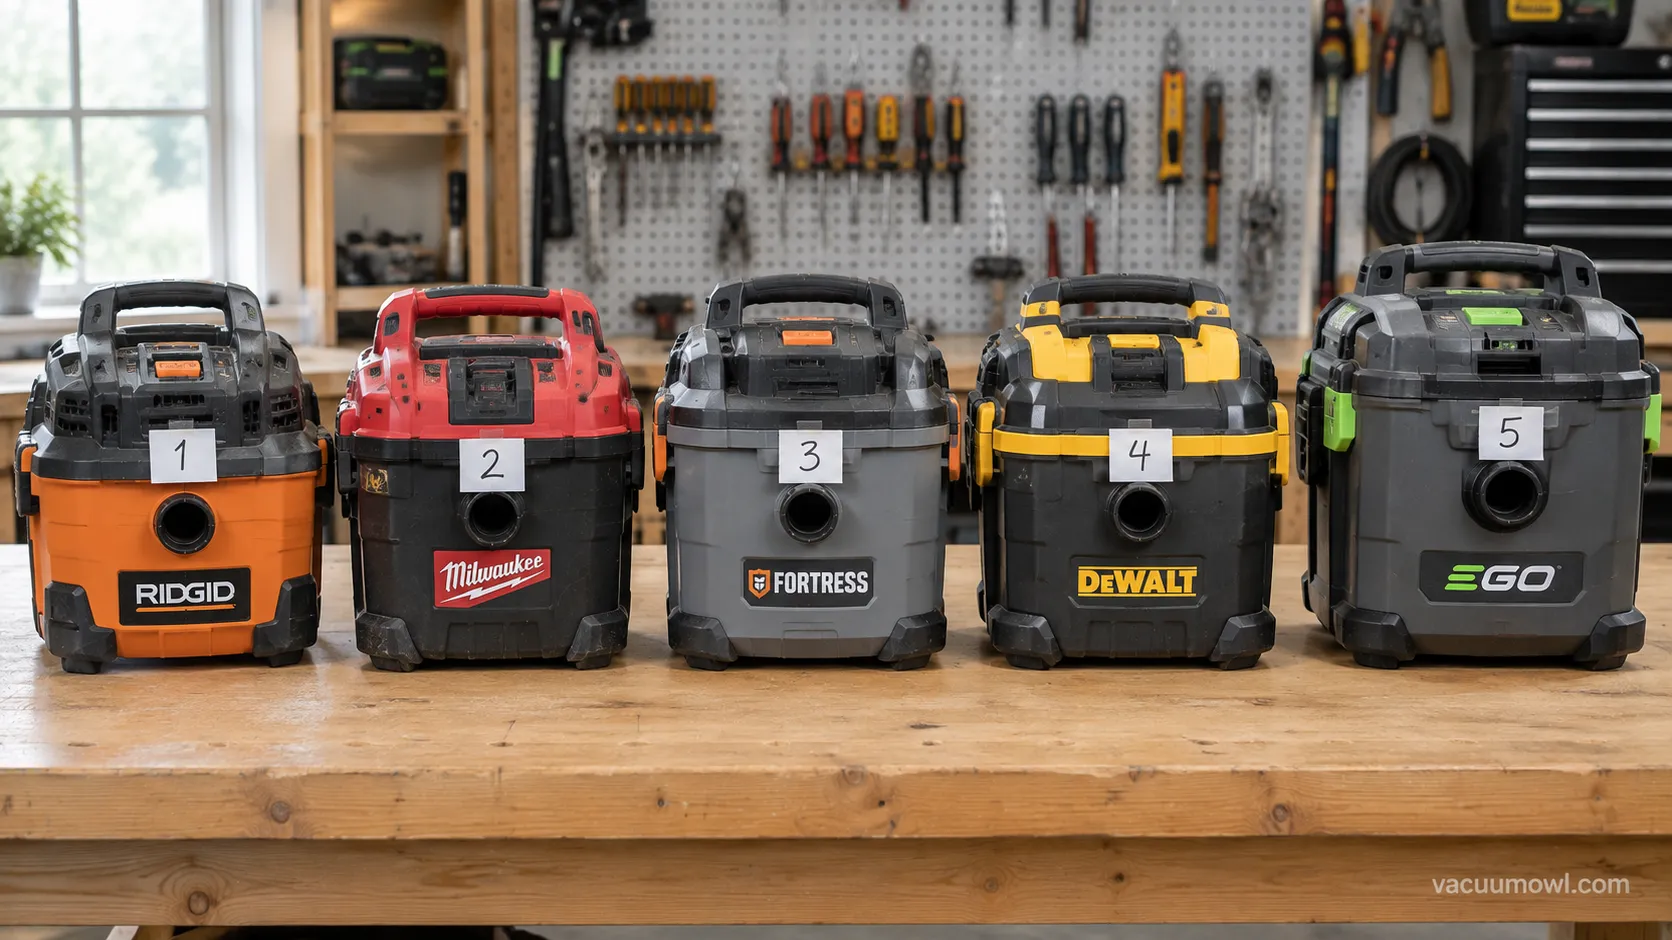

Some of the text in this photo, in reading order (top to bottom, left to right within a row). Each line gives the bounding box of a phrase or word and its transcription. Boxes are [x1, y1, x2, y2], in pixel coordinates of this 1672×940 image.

[1499, 417, 1523, 448] 5
[174, 439, 186, 471] 1
[480, 449, 504, 479] 2
[799, 441, 820, 472] 3
[1128, 440, 1151, 471] 4
[439, 554, 544, 592] Milwaukee
[774, 571, 868, 594] FORTRESS
[1444, 565, 1556, 592] EGO
[136, 581, 235, 605] RIDGID
